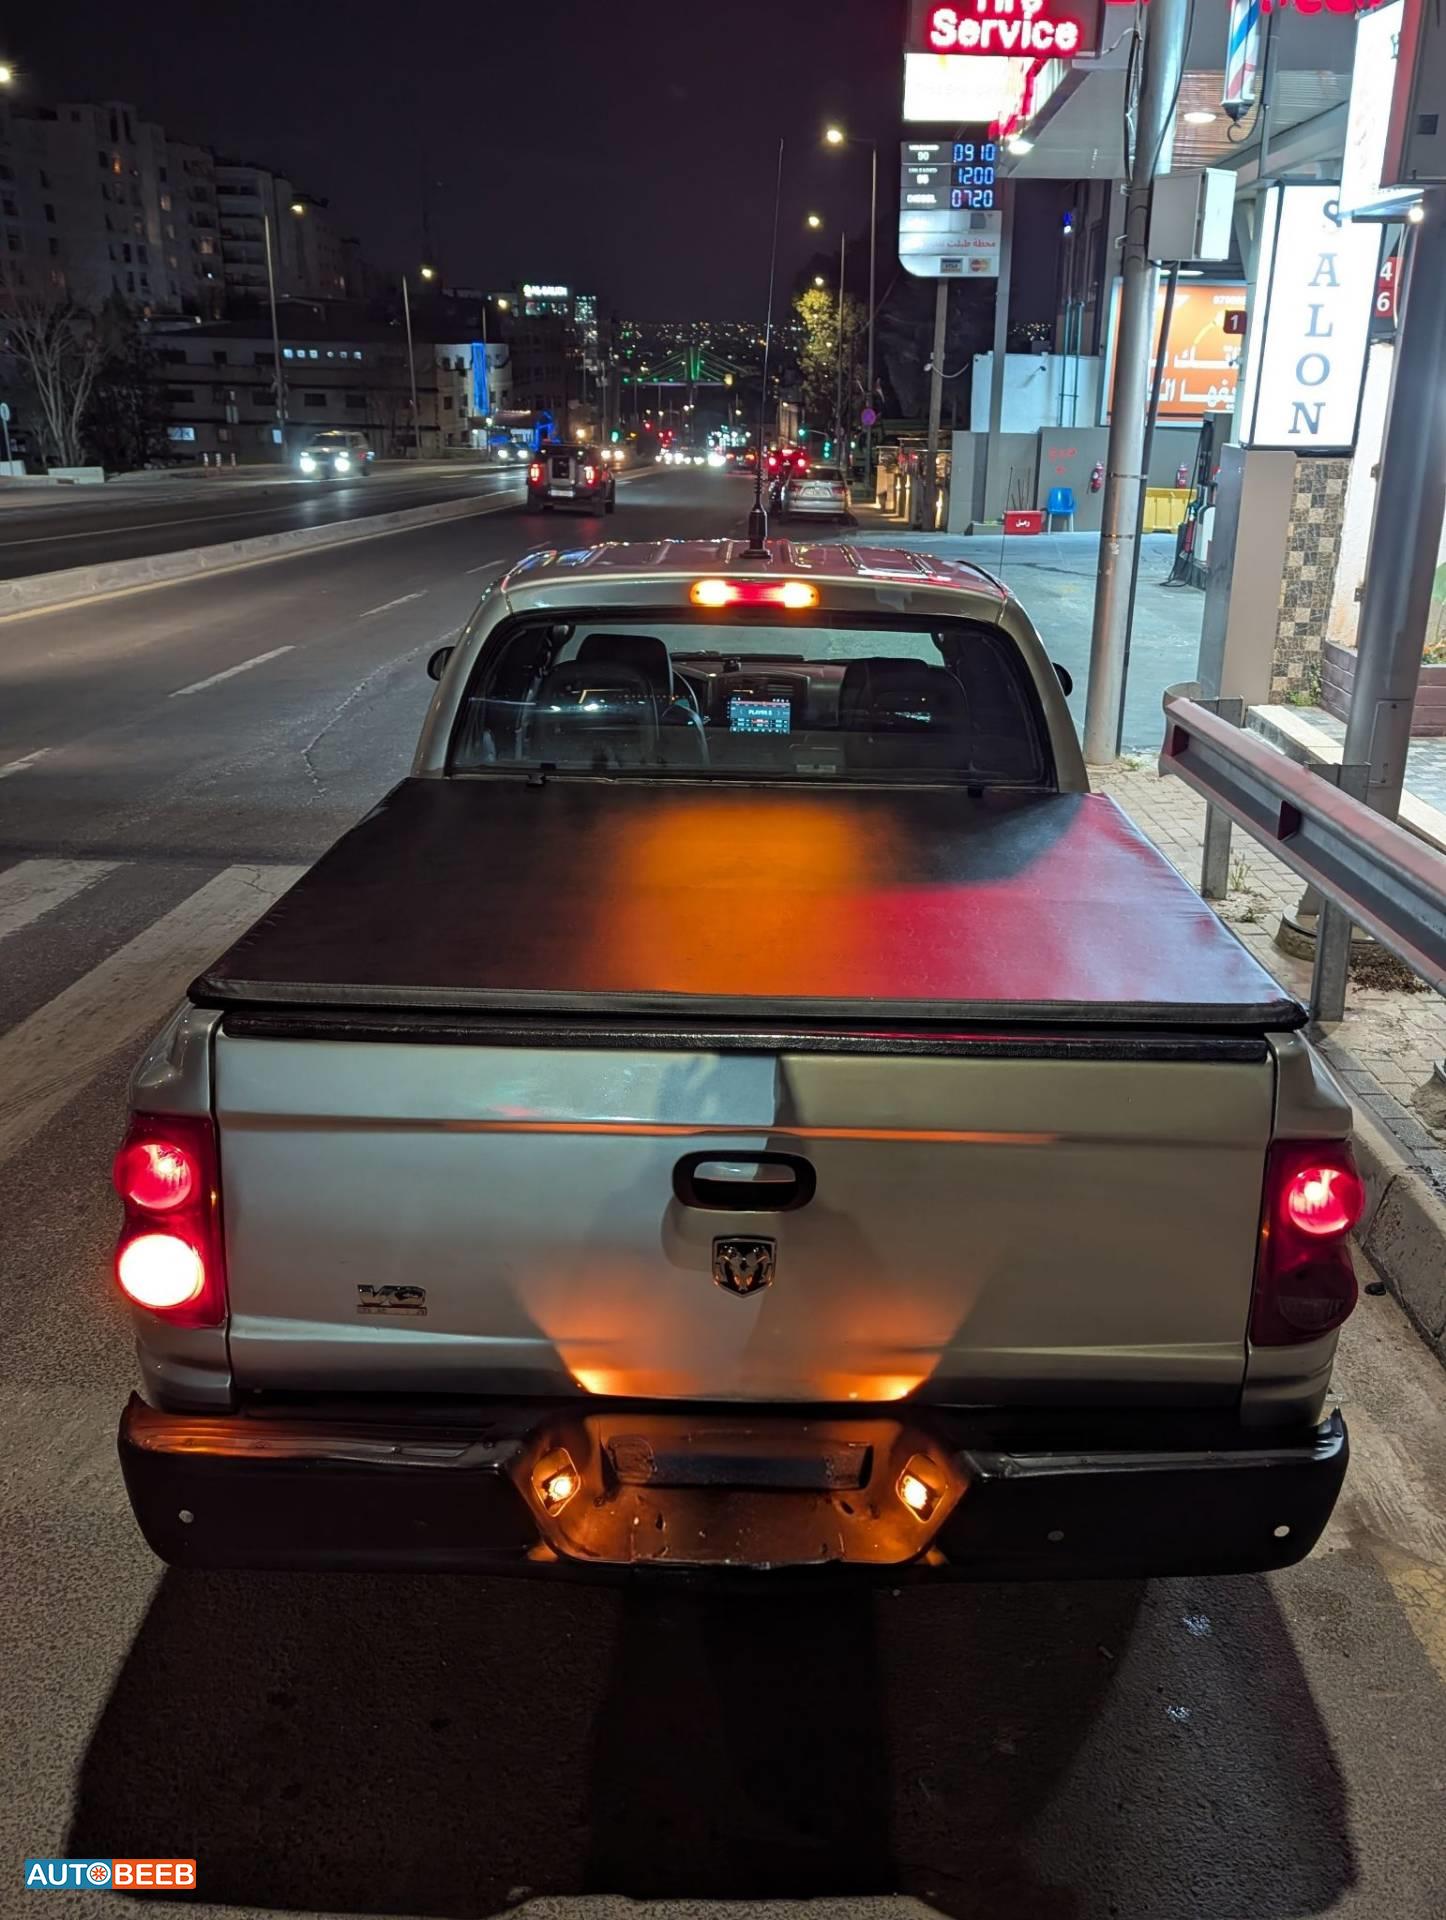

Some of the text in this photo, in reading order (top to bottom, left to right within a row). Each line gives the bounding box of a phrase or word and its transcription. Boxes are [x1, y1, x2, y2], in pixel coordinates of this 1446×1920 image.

[930, 8, 1078, 49] Service
[953, 143, 995, 161] 0910
[958, 166, 994, 185] 1200
[951, 189, 993, 208] 0720
[1379, 261, 1393, 281] 4
[1376, 292, 1391, 312] 6
[1230, 314, 1239, 331] 1
